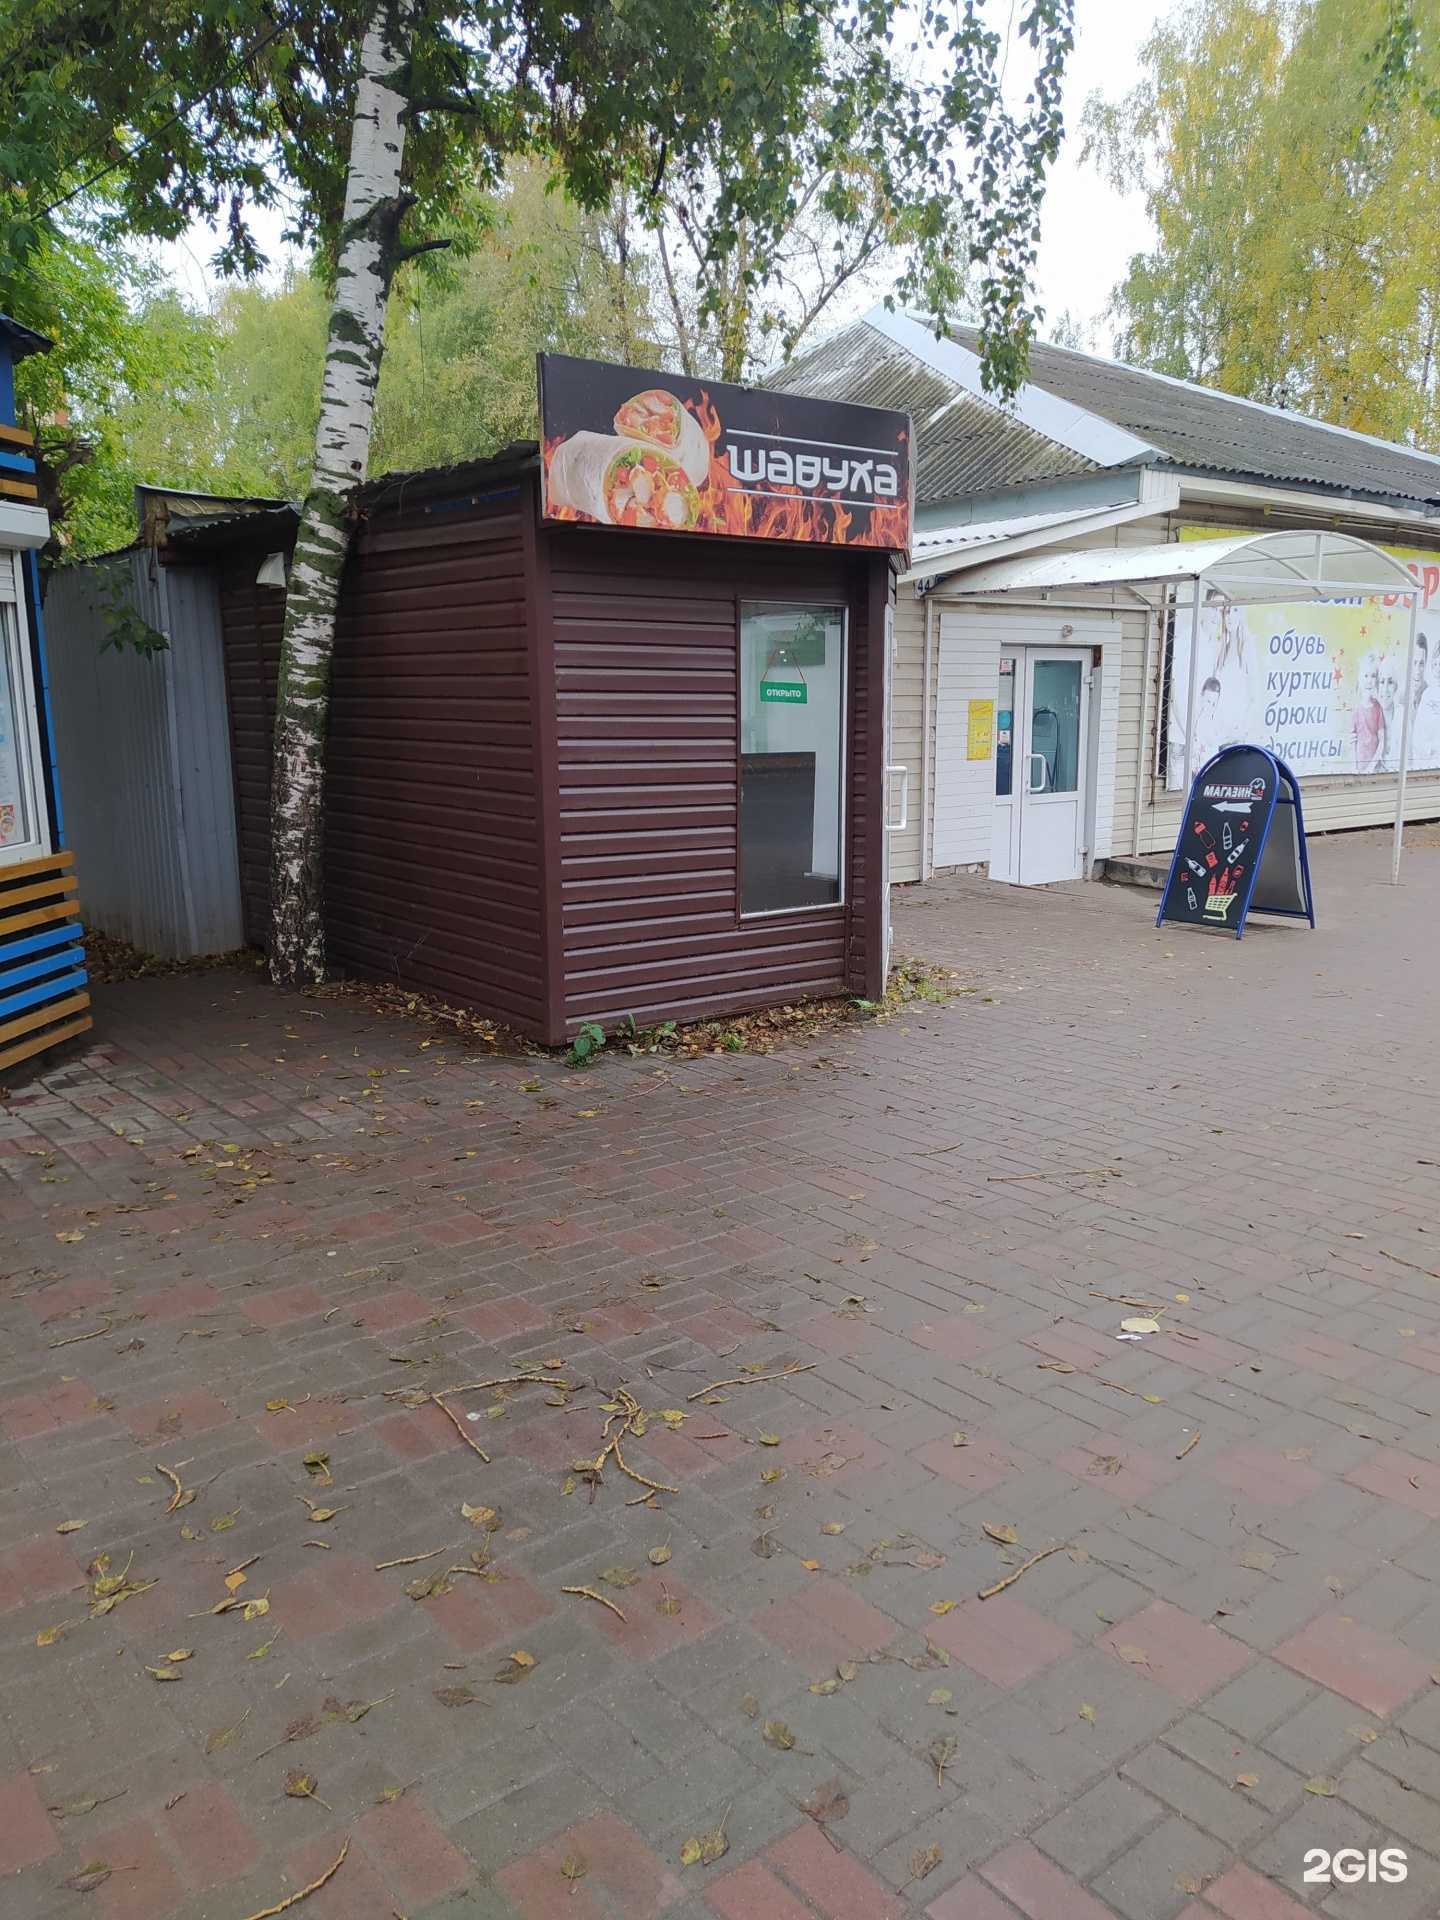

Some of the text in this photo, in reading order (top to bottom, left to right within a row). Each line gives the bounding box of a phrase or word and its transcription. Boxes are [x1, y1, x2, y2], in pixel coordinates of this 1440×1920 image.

[1269, 628, 1325, 661] обувь
[766, 688, 802, 698] ОТКРЫТО
[1267, 671, 1333, 698] куртки
[1265, 700, 1327, 733] брюки
[1203, 785, 1252, 798] МАГАЗИН
